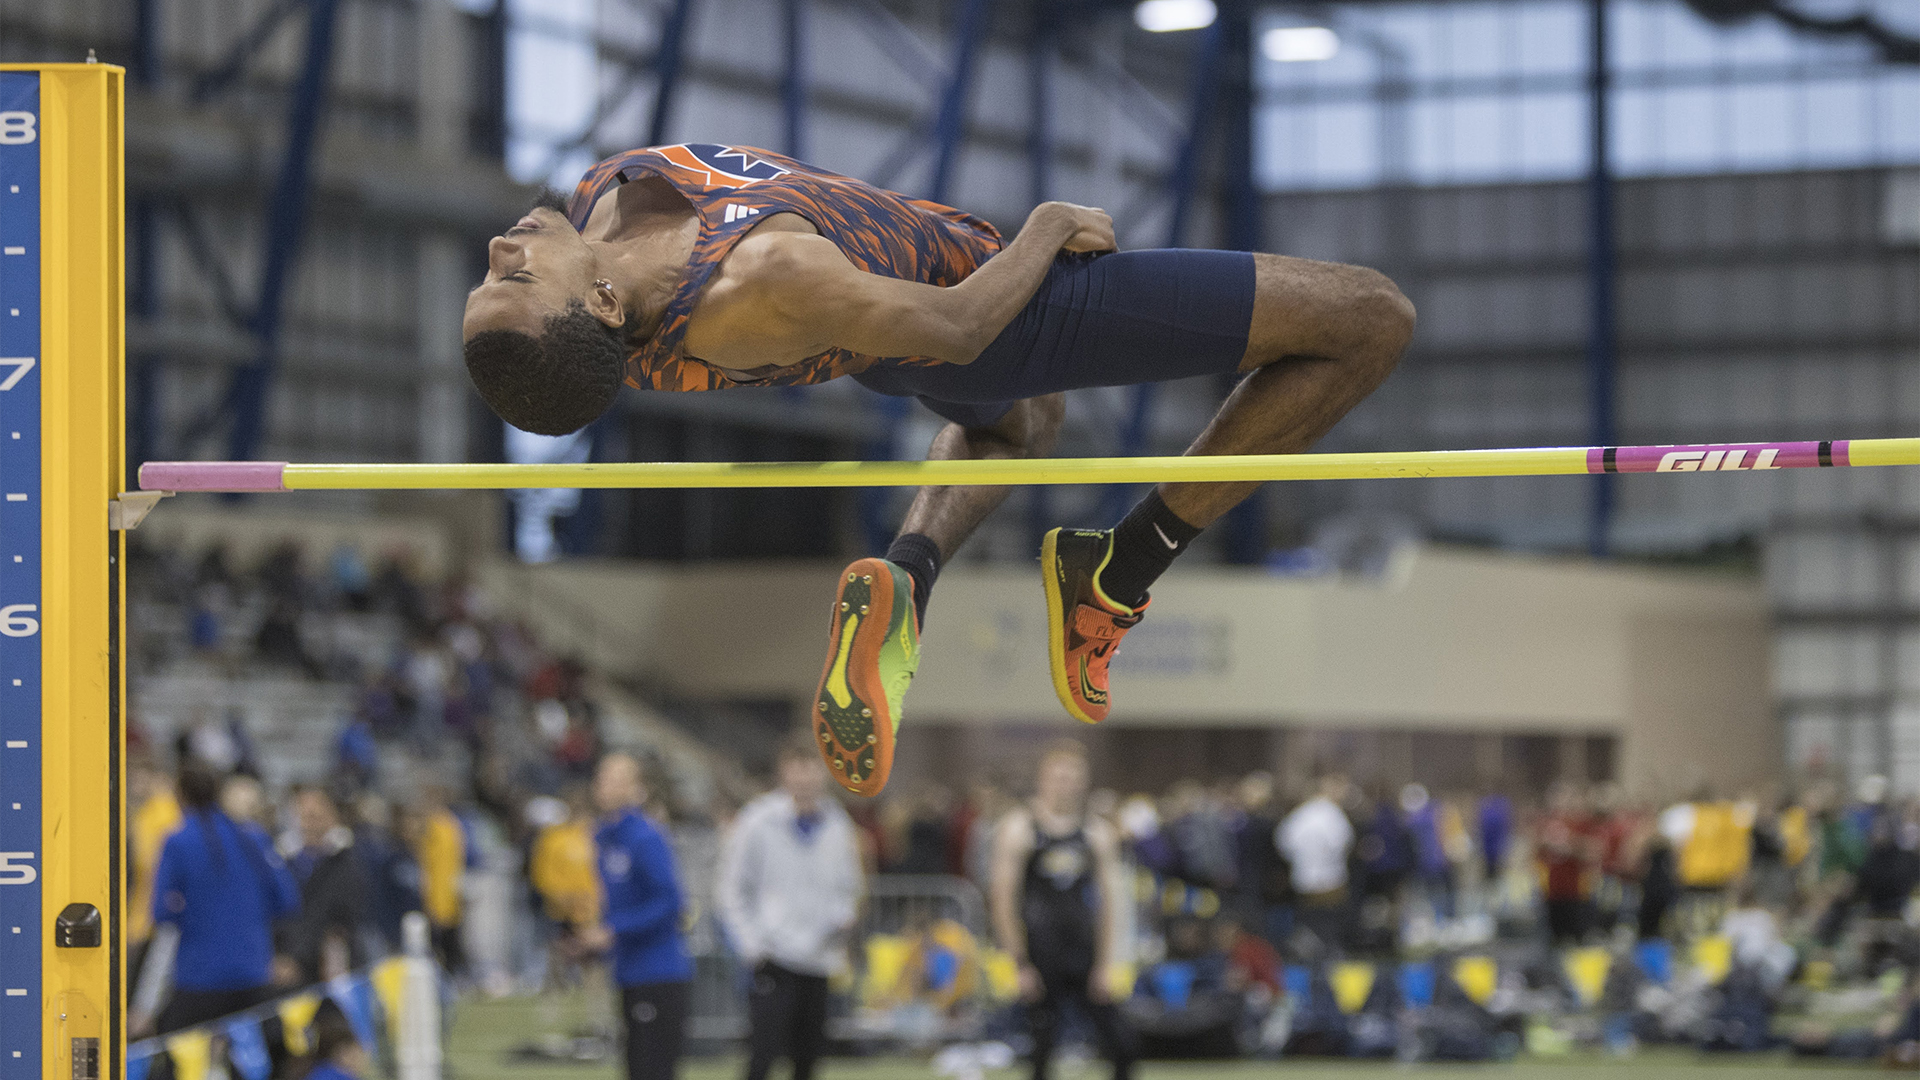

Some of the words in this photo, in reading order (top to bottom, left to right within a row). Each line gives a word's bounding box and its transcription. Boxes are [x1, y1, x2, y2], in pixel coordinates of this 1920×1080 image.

[0, 111, 37, 145] 8
[0, 357, 36, 391] 7
[1656, 449, 1782, 472] GILL
[0, 604, 39, 638] 6
[0, 852, 37, 885] 5
